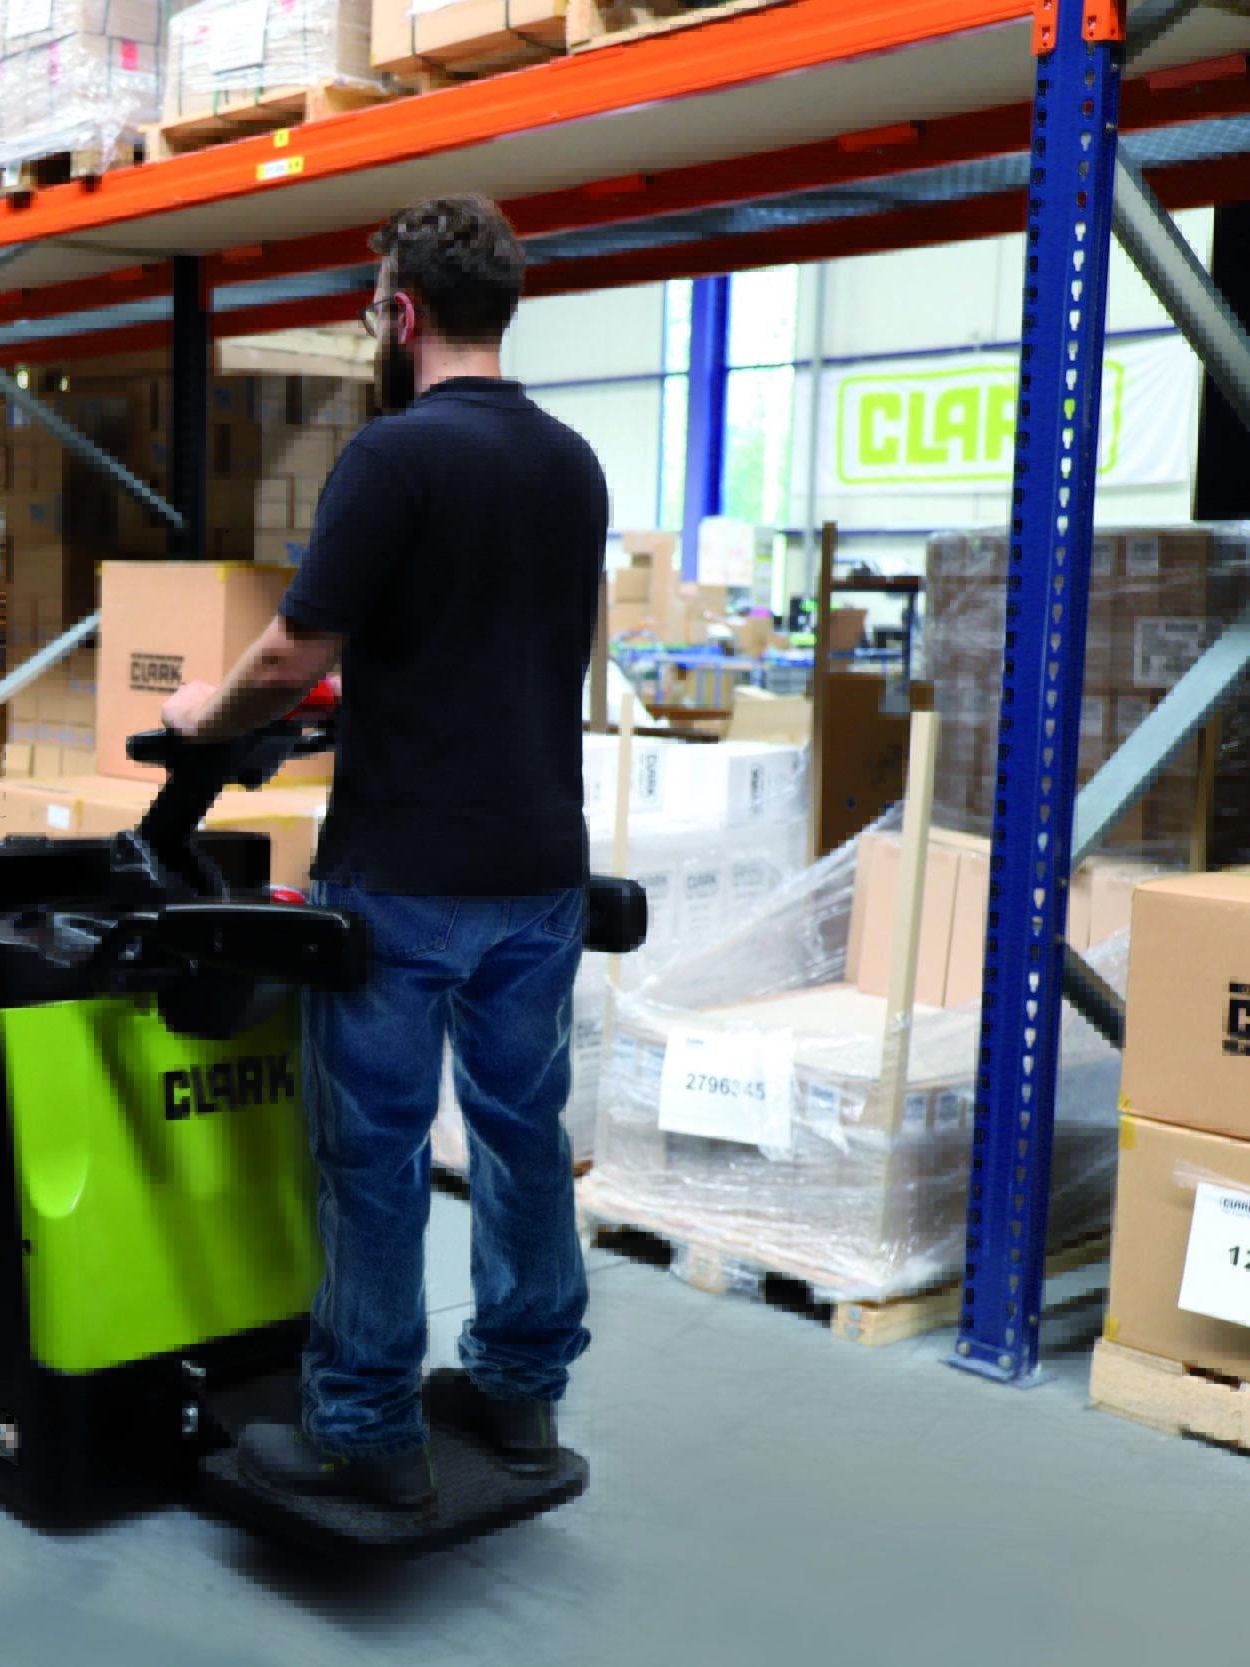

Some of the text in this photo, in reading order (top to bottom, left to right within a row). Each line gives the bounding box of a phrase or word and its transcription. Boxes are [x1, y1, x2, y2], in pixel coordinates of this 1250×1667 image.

[858, 383, 1019, 466] CLAR
[130, 660, 183, 687] CLARK
[164, 1058, 295, 1121] CLARK
